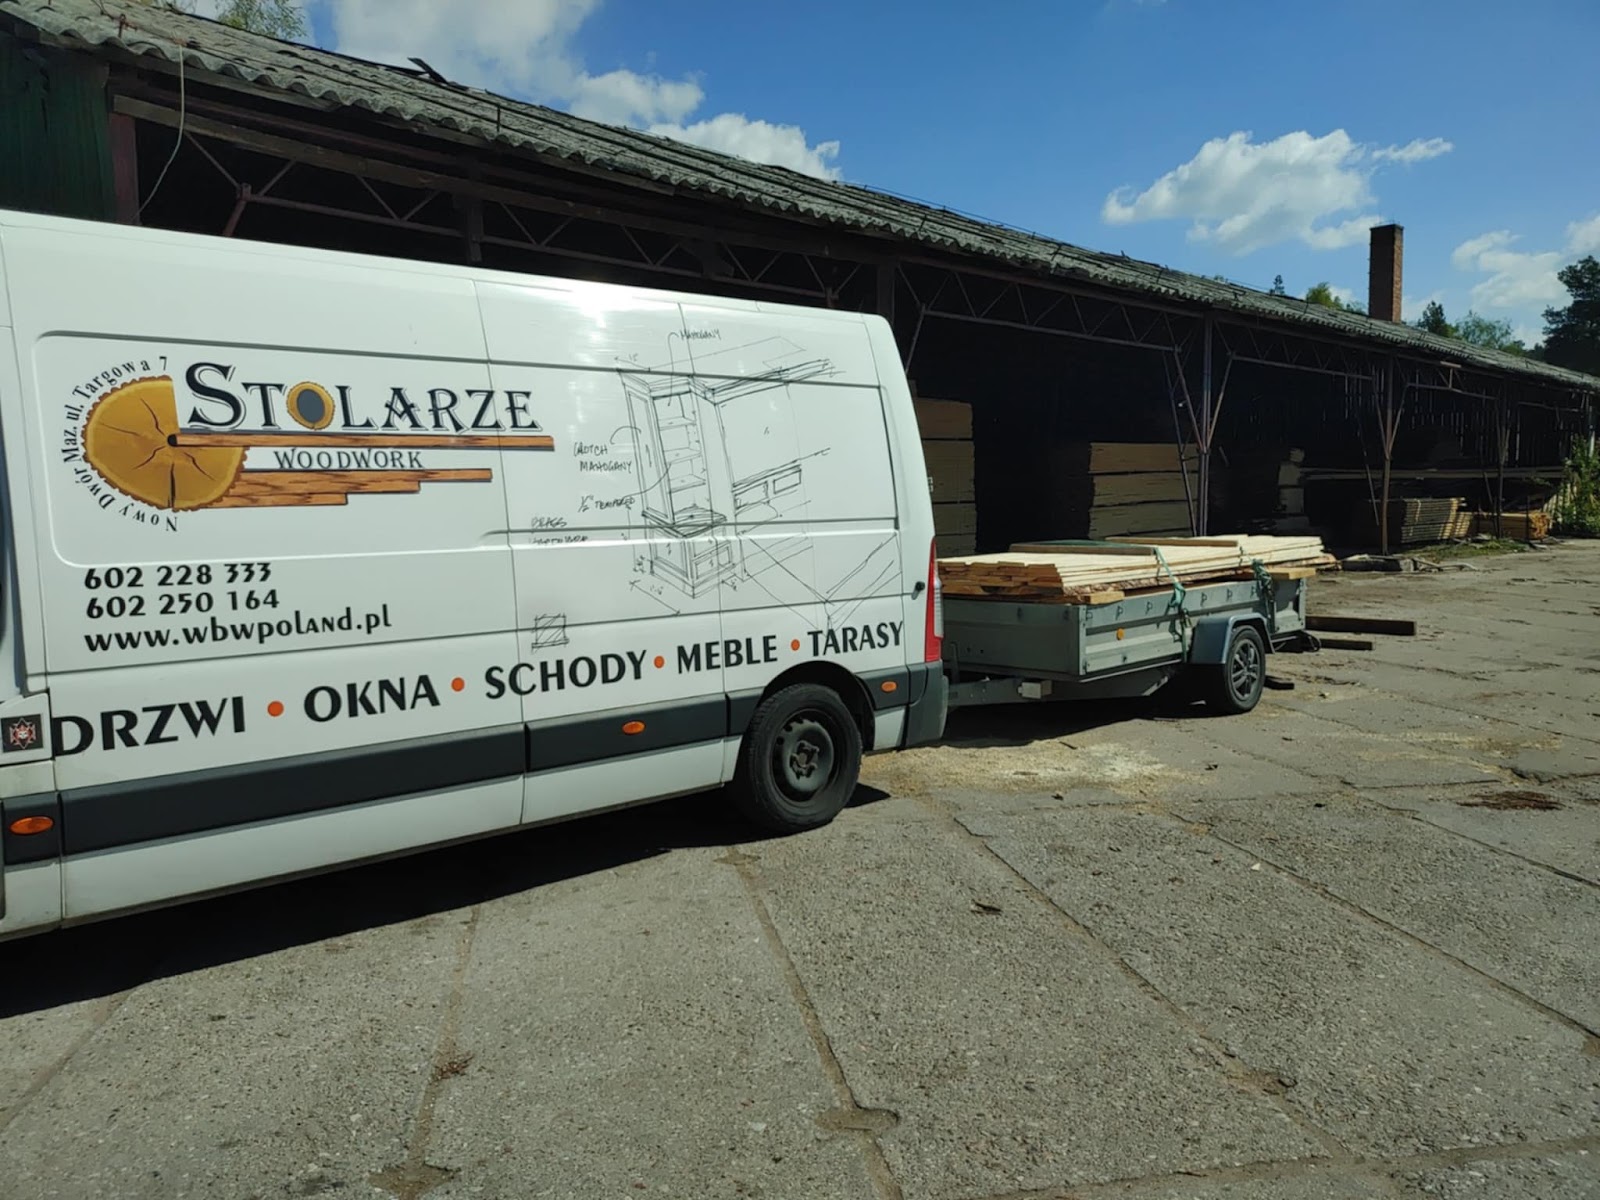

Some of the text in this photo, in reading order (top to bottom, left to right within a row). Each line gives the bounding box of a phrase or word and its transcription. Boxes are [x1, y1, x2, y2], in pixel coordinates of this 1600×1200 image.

[185, 362, 543, 433] STOLARZE
[61, 356, 178, 532] Nowy Dwór Maz. ul. Targowa 7
[273, 450, 424, 470] WOODWORK
[84, 562, 272, 590] 602 228 333
[86, 589, 280, 619] 602 250 164
[52, 620, 903, 757] DRZWI OKNA SCHODY MEBLE TARASY
